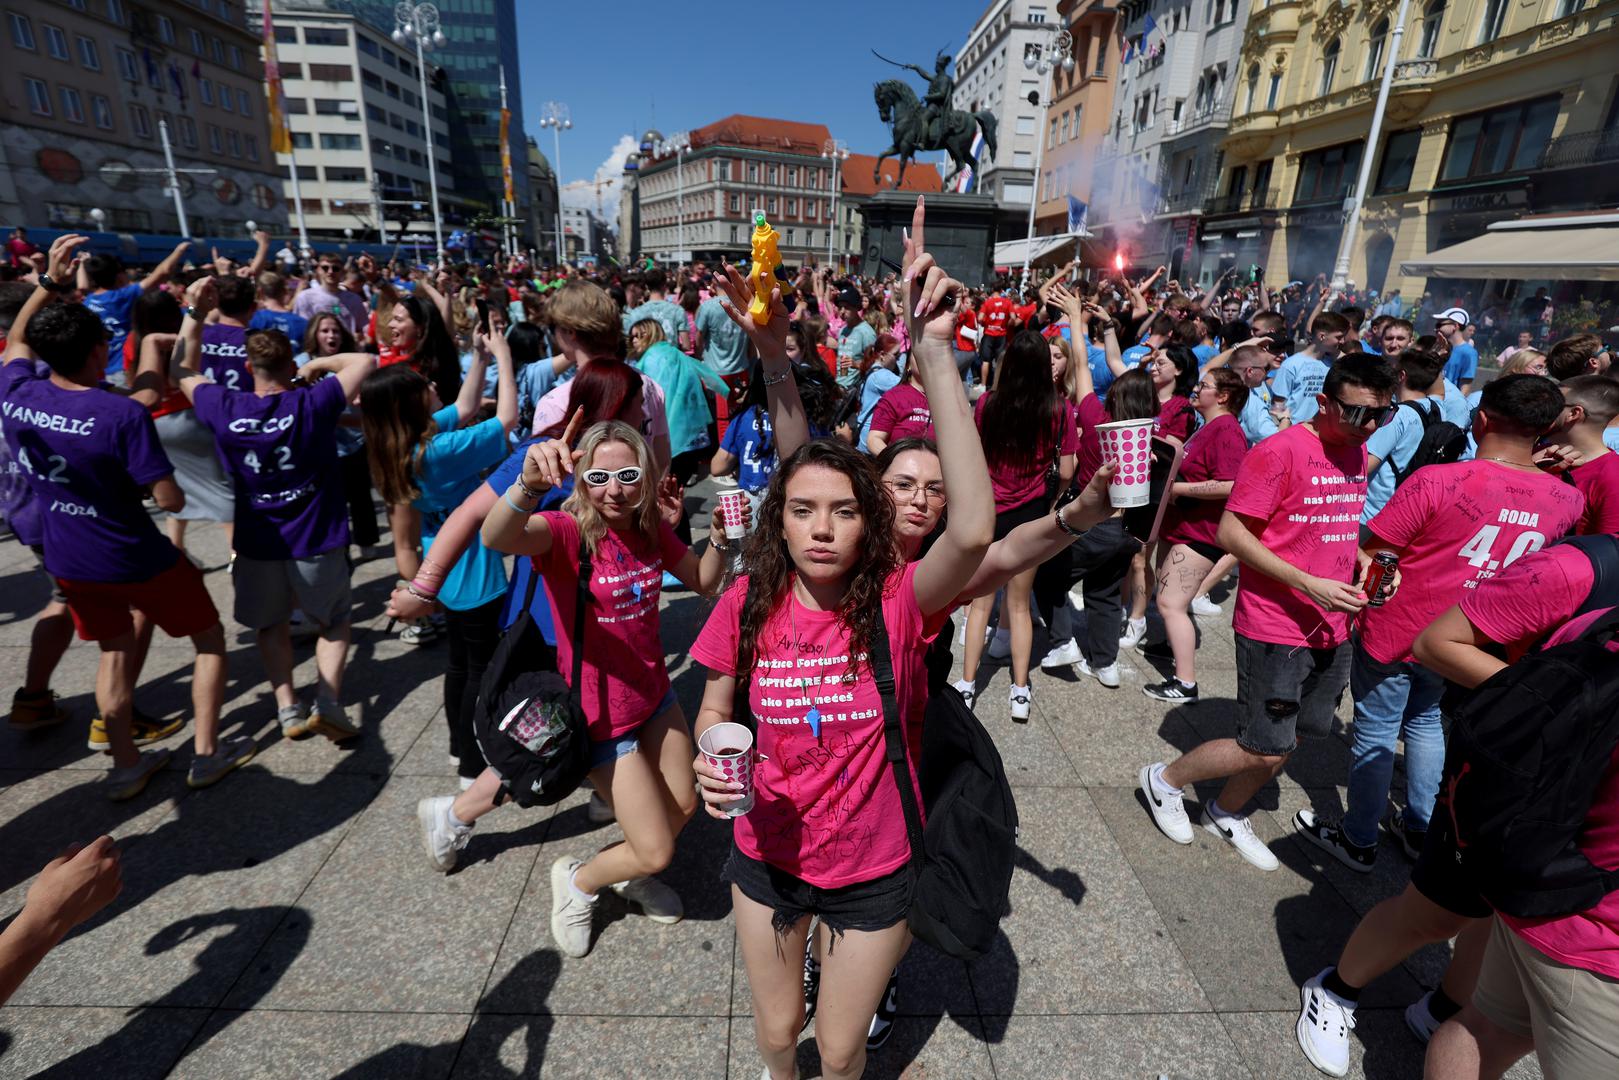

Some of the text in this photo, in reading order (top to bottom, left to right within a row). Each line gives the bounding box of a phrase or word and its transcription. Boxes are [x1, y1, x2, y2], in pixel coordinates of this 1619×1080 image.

[18, 446, 71, 484] 4.2
[243, 445, 296, 474] 4.2
[1311, 476, 1319, 486] O
[1303, 496, 1324, 505] nas
[1497, 508, 1540, 529] RODA
[796, 655, 849, 668] Fortuno
[759, 675, 822, 688] OPTIČARE
[761, 697, 783, 707] ako
[814, 692, 854, 705] nećeš
[803, 713, 834, 725] sas
[837, 713, 847, 721] u
